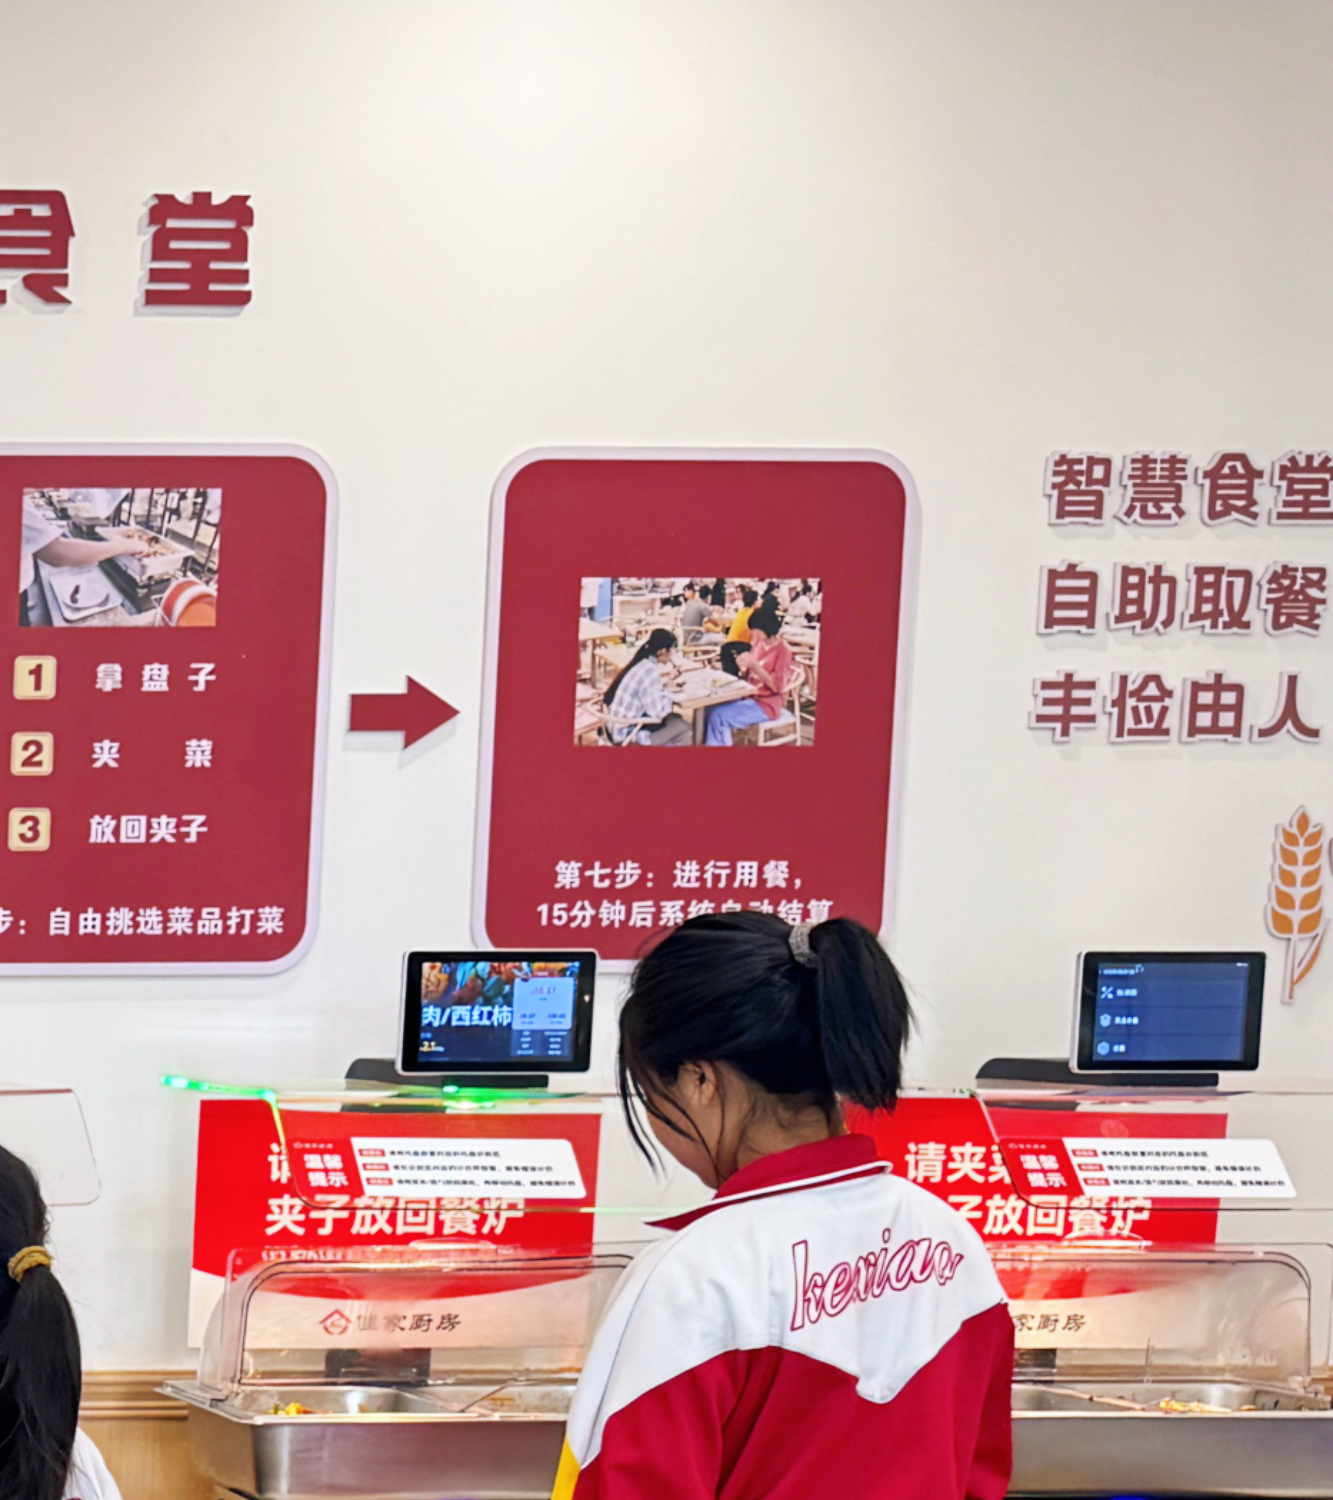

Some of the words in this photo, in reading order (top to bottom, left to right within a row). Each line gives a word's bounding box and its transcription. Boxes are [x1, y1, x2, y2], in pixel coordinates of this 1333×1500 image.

[1050, 452, 1333, 522] 智慧食堂
[1043, 563, 1327, 632] 自助取餐
[28, 664, 44, 692] 1
[95, 663, 218, 692] 拿盘子
[1035, 672, 1321, 741] 丰俭由人
[20, 739, 44, 768] 2
[17, 815, 41, 844] 3
[88, 814, 209, 845] 放回夹子
[264, 1194, 526, 1236] 夹子放回餐炉
[355, 1312, 462, 1334] 佳家厨房
